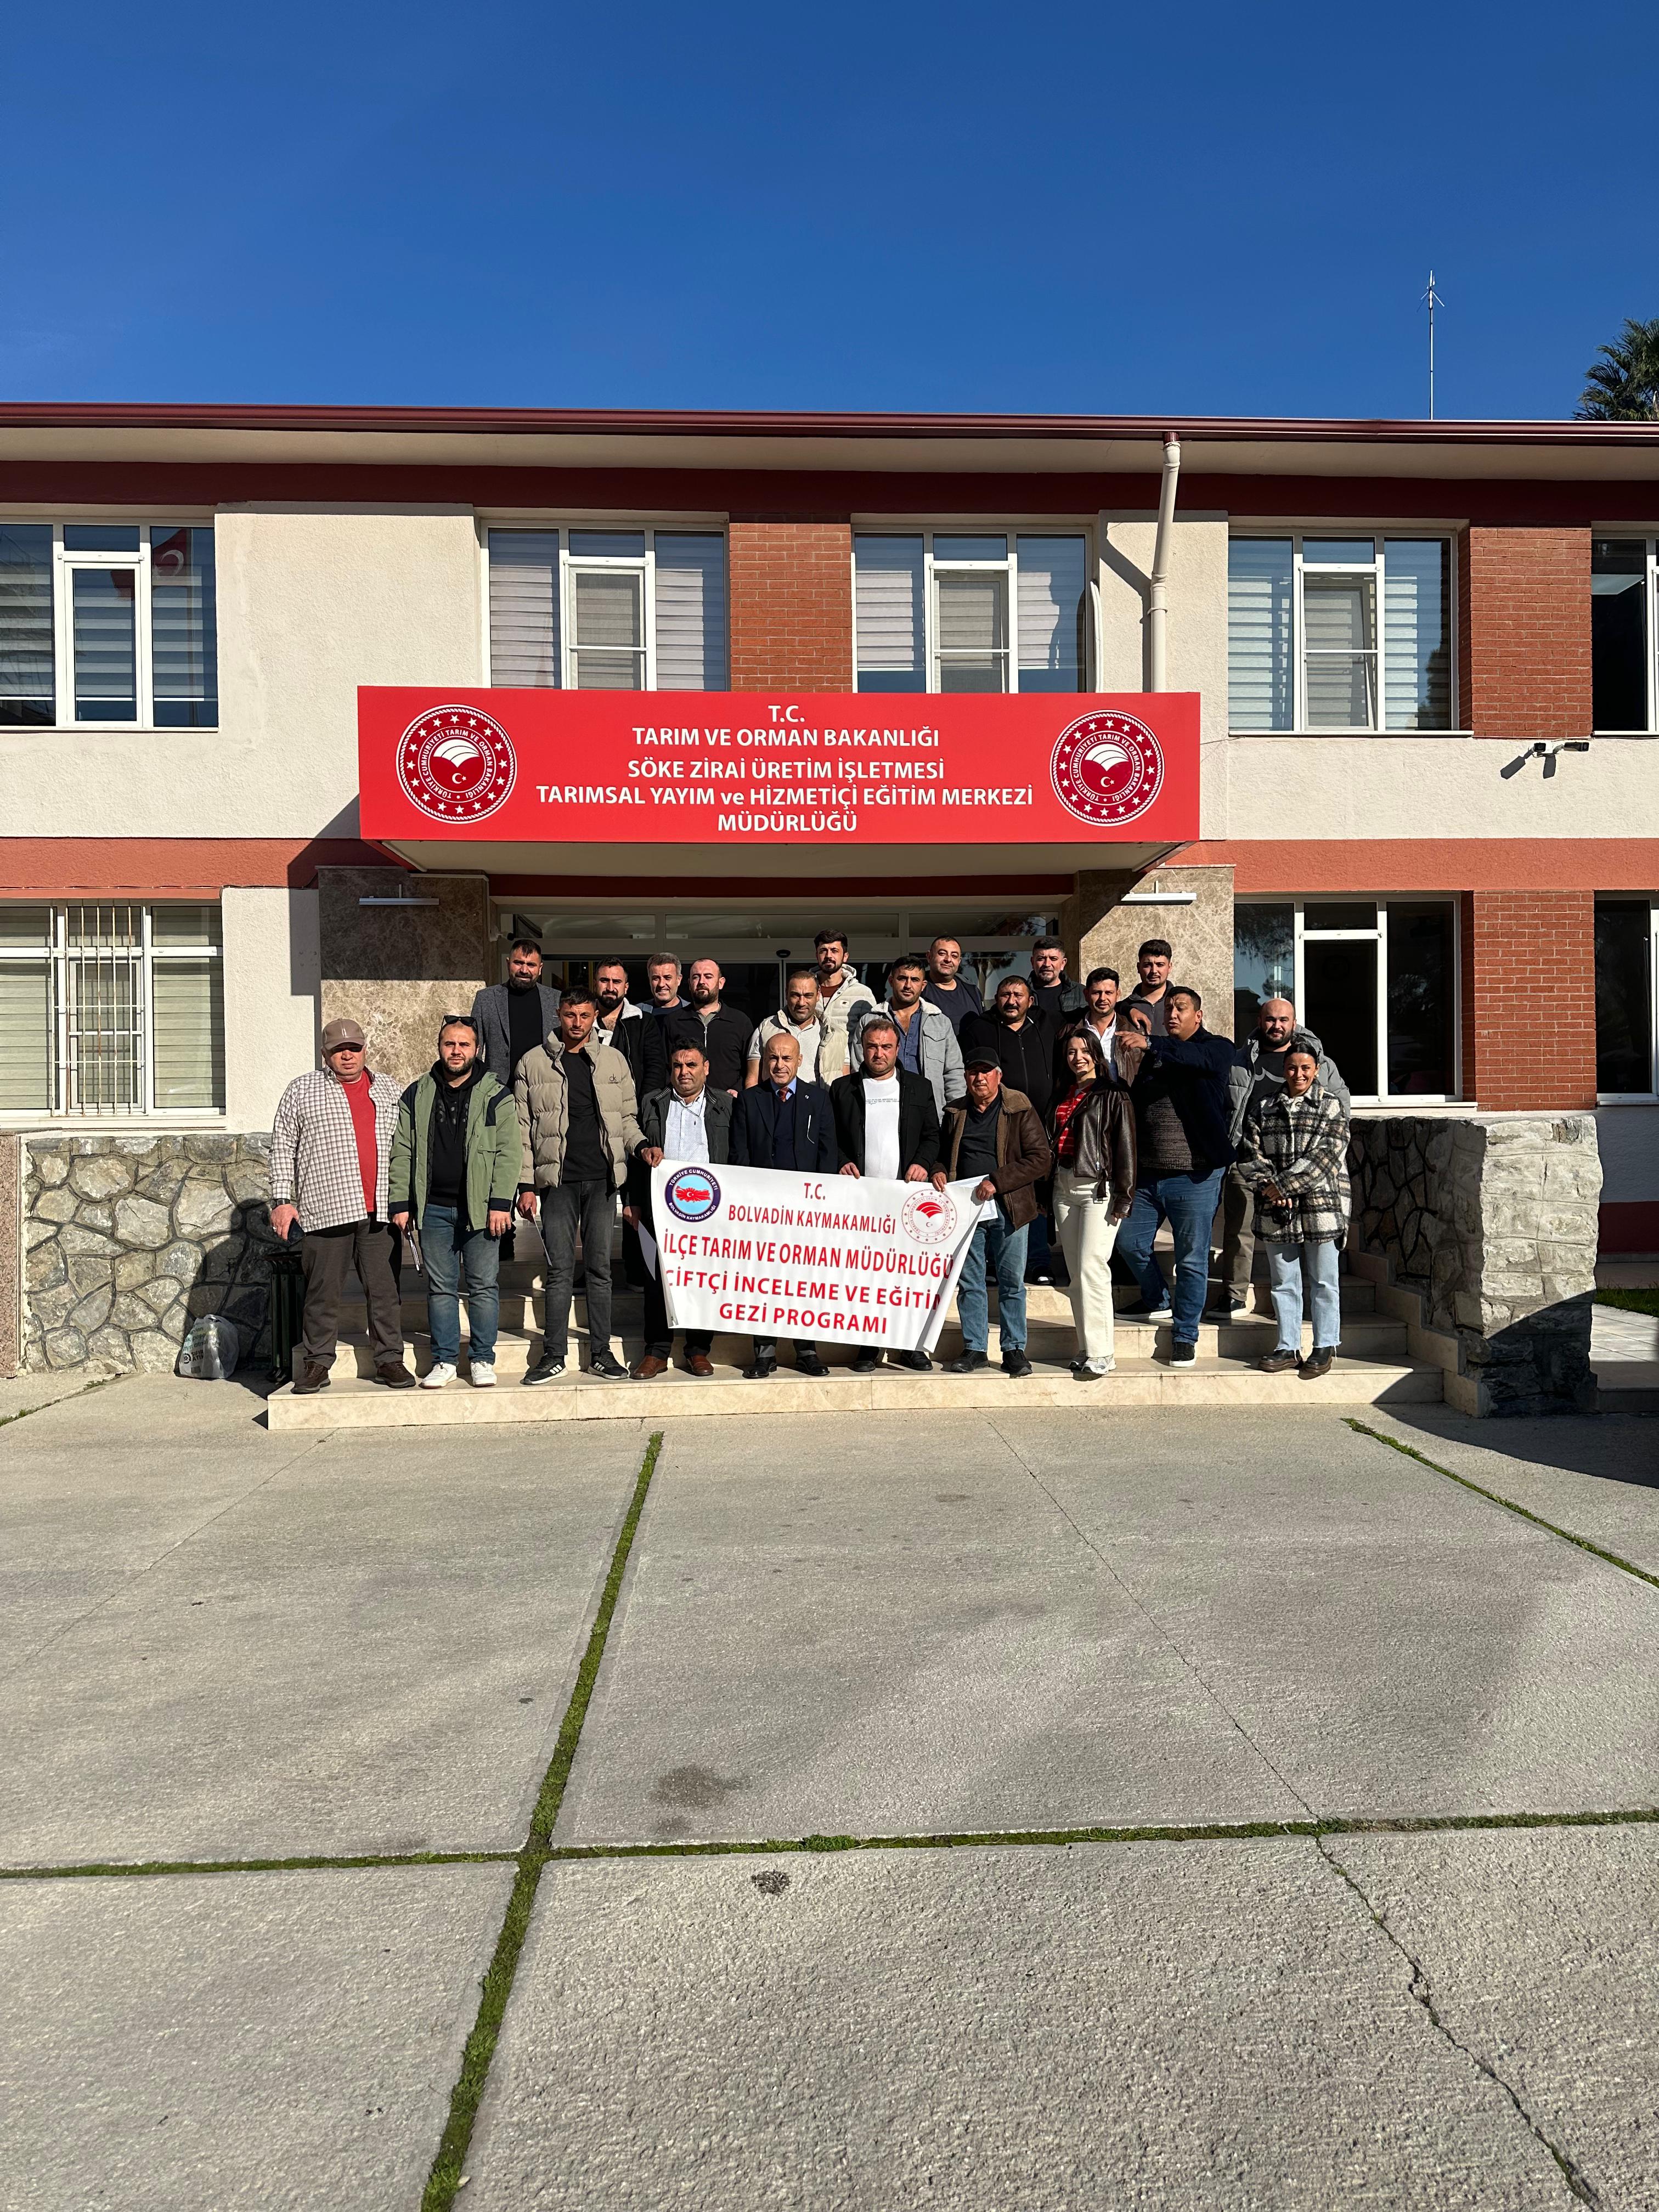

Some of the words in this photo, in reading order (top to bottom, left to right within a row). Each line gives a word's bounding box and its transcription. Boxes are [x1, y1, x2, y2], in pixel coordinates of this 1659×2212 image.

[768, 705, 805, 723] T.C.
[470, 733, 479, 742] VE
[632, 727, 699, 746] TARIM
[704, 729, 731, 746] VE
[737, 729, 817, 746] ORMAN
[824, 726, 939, 747] BAKANLIĞI
[1121, 738, 1130, 747] VE
[421, 731, 445, 776] CUMHURİYETİ
[479, 741, 493, 766] ORMAN
[1073, 735, 1097, 778] CUMHURİYETİ
[1128, 747, 1141, 771] ORMAN
[628, 757, 684, 778] SÖKE
[690, 757, 745, 778] ZİRAİ
[752, 757, 832, 779] ÜRETİM
[838, 757, 944, 783] İŞLETMESİ
[425, 776, 452, 799] TÜRKİYE
[465, 768, 493, 799] BAKANLIĞI
[1075, 779, 1099, 802] TÜRKİYE
[1112, 772, 1140, 802] BAKANLIĞI
[535, 786, 646, 804] TARIMSAL
[650, 787, 715, 805] YAYIM
[720, 792, 744, 805] ve
[751, 784, 857, 810] HİZMETİÇİ
[864, 784, 935, 805] EĞİTİM
[942, 784, 1032, 805] MERKEZİ
[718, 810, 857, 832] MÜDÜRLÜĞÜ
[804, 1182, 826, 1200] T.C.
[728, 1204, 794, 1226] BOLVADİN
[797, 1210, 896, 1235] KAYMAKAMLIĞI
[664, 1228, 698, 1260] İLÇE
[701, 1236, 752, 1260] TARIM
[756, 1241, 776, 1262] VE
[779, 1243, 841, 1268] ORMAN
[845, 1245, 953, 1279] MÜDÜRLÜĞÜ
[734, 1272, 839, 1300] İNCELEME
[845, 1284, 870, 1303] VE
[719, 1302, 767, 1323] GEZİ
[773, 1307, 887, 1334] PROGRAMI
